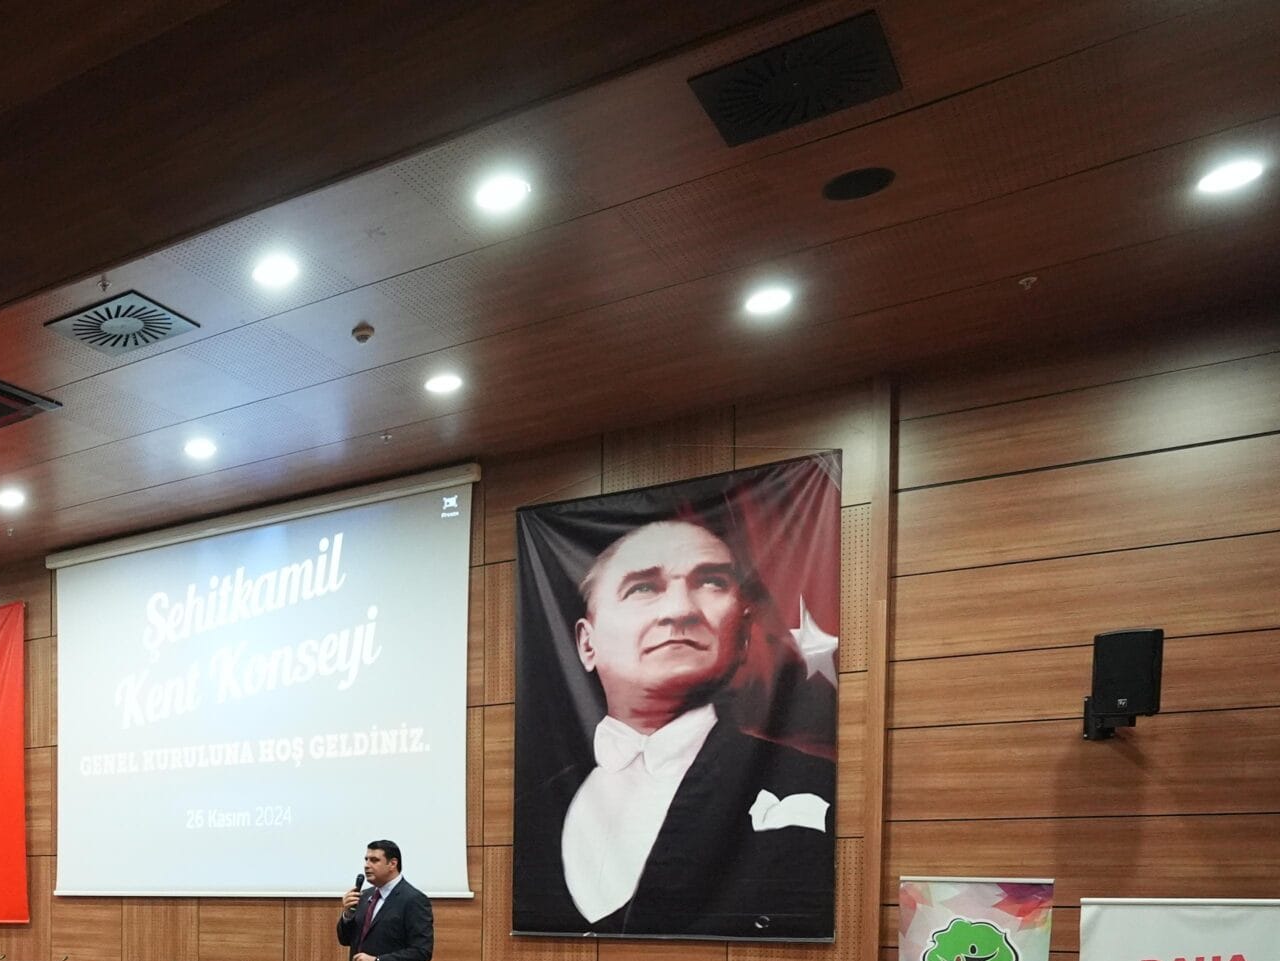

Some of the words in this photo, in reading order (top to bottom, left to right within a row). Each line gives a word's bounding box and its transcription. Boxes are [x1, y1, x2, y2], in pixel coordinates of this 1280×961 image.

[143, 533, 347, 663] Şehitkamil
[115, 667, 204, 729] Kent
[208, 606, 383, 704] Konseyi
[80, 751, 139, 777] GENEL
[142, 742, 255, 773] KURULUNA
[259, 737, 305, 768] HOŞ
[308, 722, 431, 759] GELDİNİZ.
[186, 809, 204, 829] 26
[207, 807, 251, 829] Kasım
[255, 805, 292, 827] 2024
